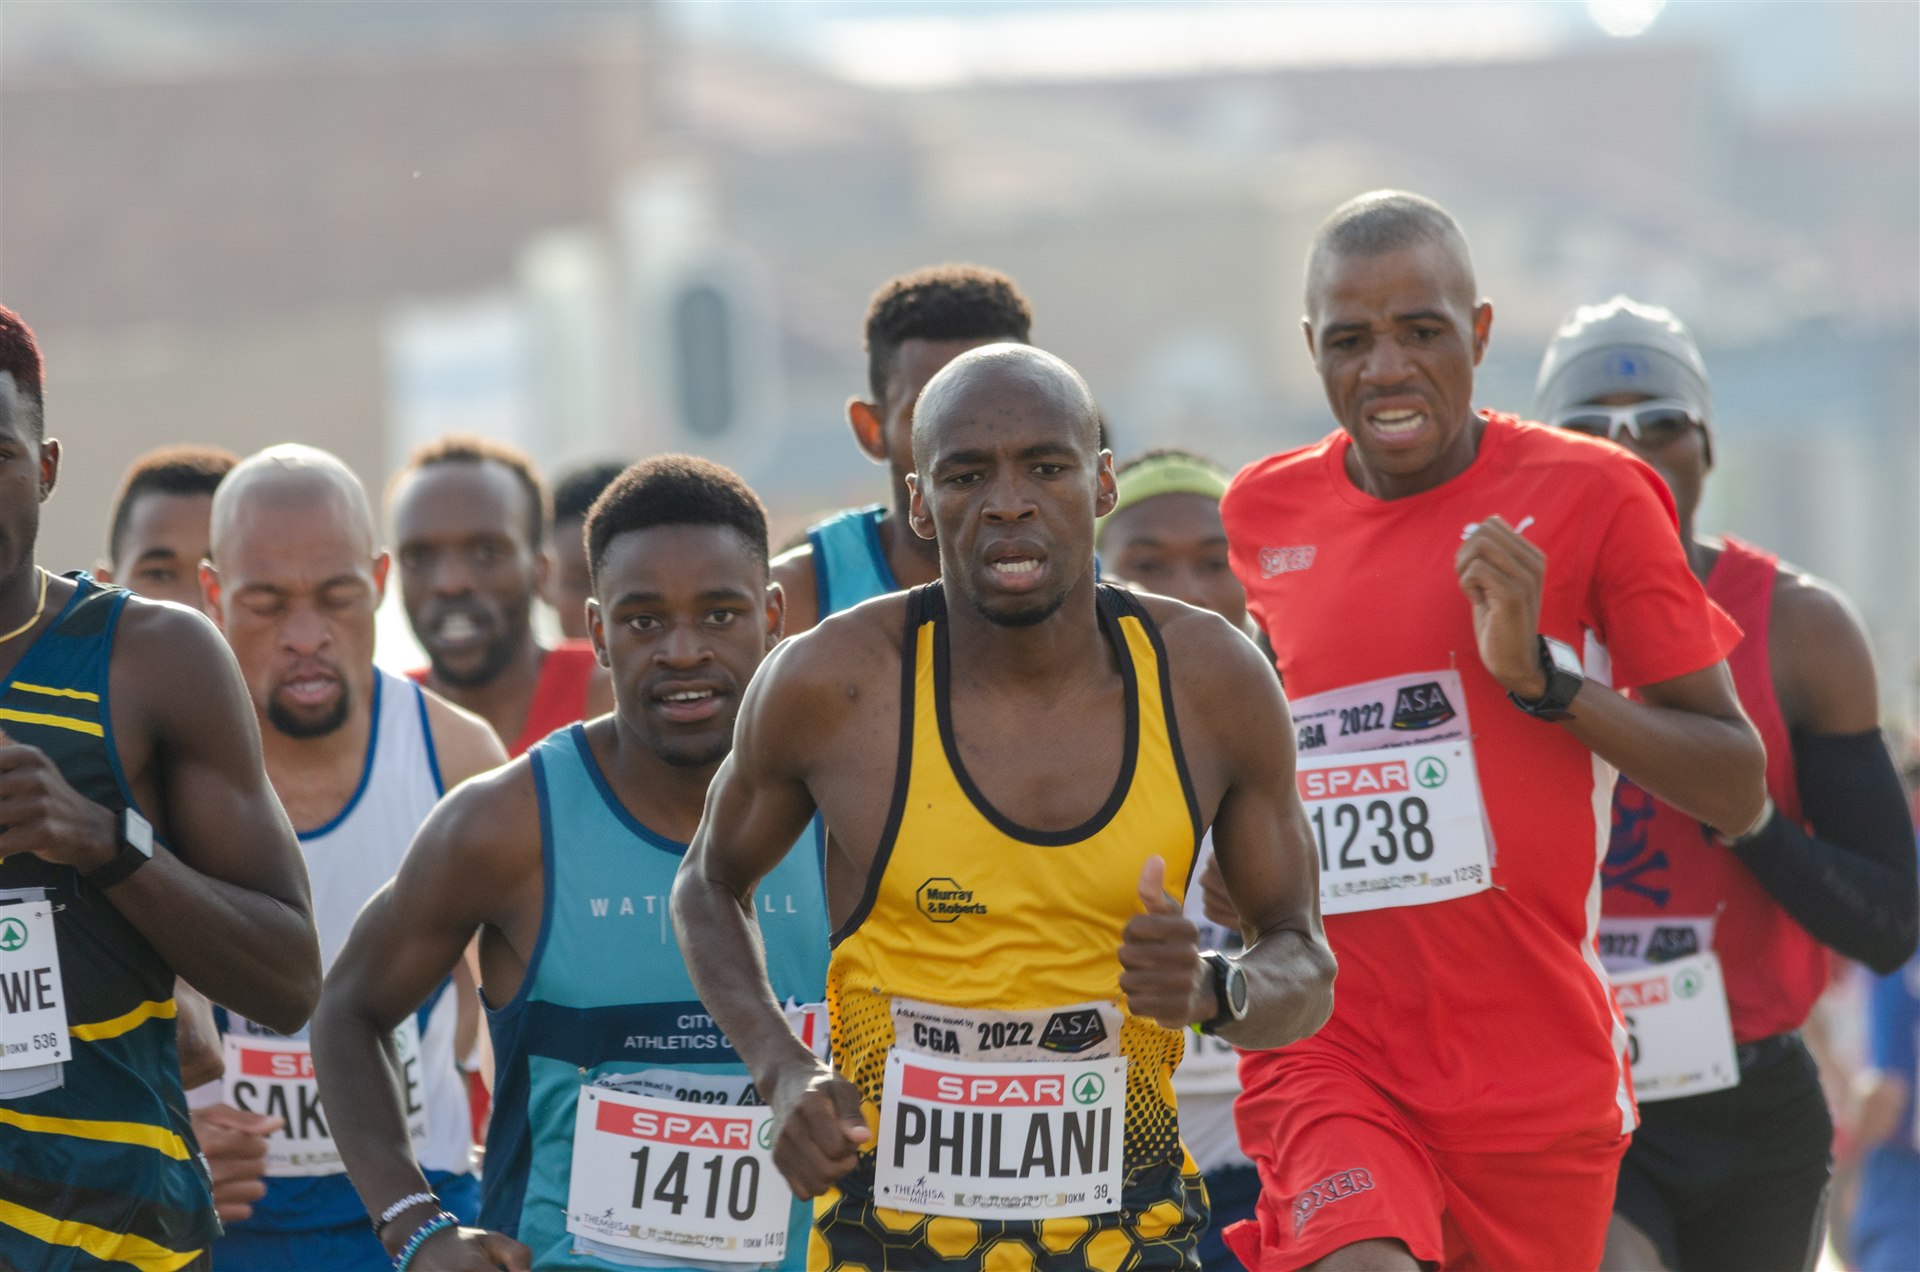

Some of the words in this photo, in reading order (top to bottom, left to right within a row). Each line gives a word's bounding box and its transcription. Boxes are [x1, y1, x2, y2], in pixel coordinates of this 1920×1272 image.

[1339, 702, 1384, 737] 2022
[1399, 687, 1446, 714] ASA
[1306, 765, 1407, 796] SPAR
[1312, 796, 1434, 872] 1238
[1454, 864, 1482, 882] 1238
[927, 889, 973, 903] Murray
[928, 903, 937, 913] &
[939, 903, 987, 914] Roberts
[1616, 978, 1669, 1004] AR
[6, 1043, 28, 1054] 10KM
[33, 1032, 57, 1050] 536
[624, 1034, 717, 1050] ATHLETICS
[913, 1022, 960, 1054] CGA
[978, 1021, 1033, 1051] 2022
[1048, 1013, 1101, 1036] ASA
[937, 1076, 1062, 1103] SPAR
[632, 1112, 749, 1145] SPAR
[893, 1102, 1112, 1178] PHILANI
[630, 1145, 760, 1222] 1410
[894, 1184, 945, 1200] THEMBISA
[1064, 1192, 1086, 1204] 10KM
[1093, 1184, 1109, 1199] 39
[583, 1213, 630, 1232] THEMBISA
[743, 1238, 762, 1248] 10KM
[764, 1231, 785, 1248] 1410
